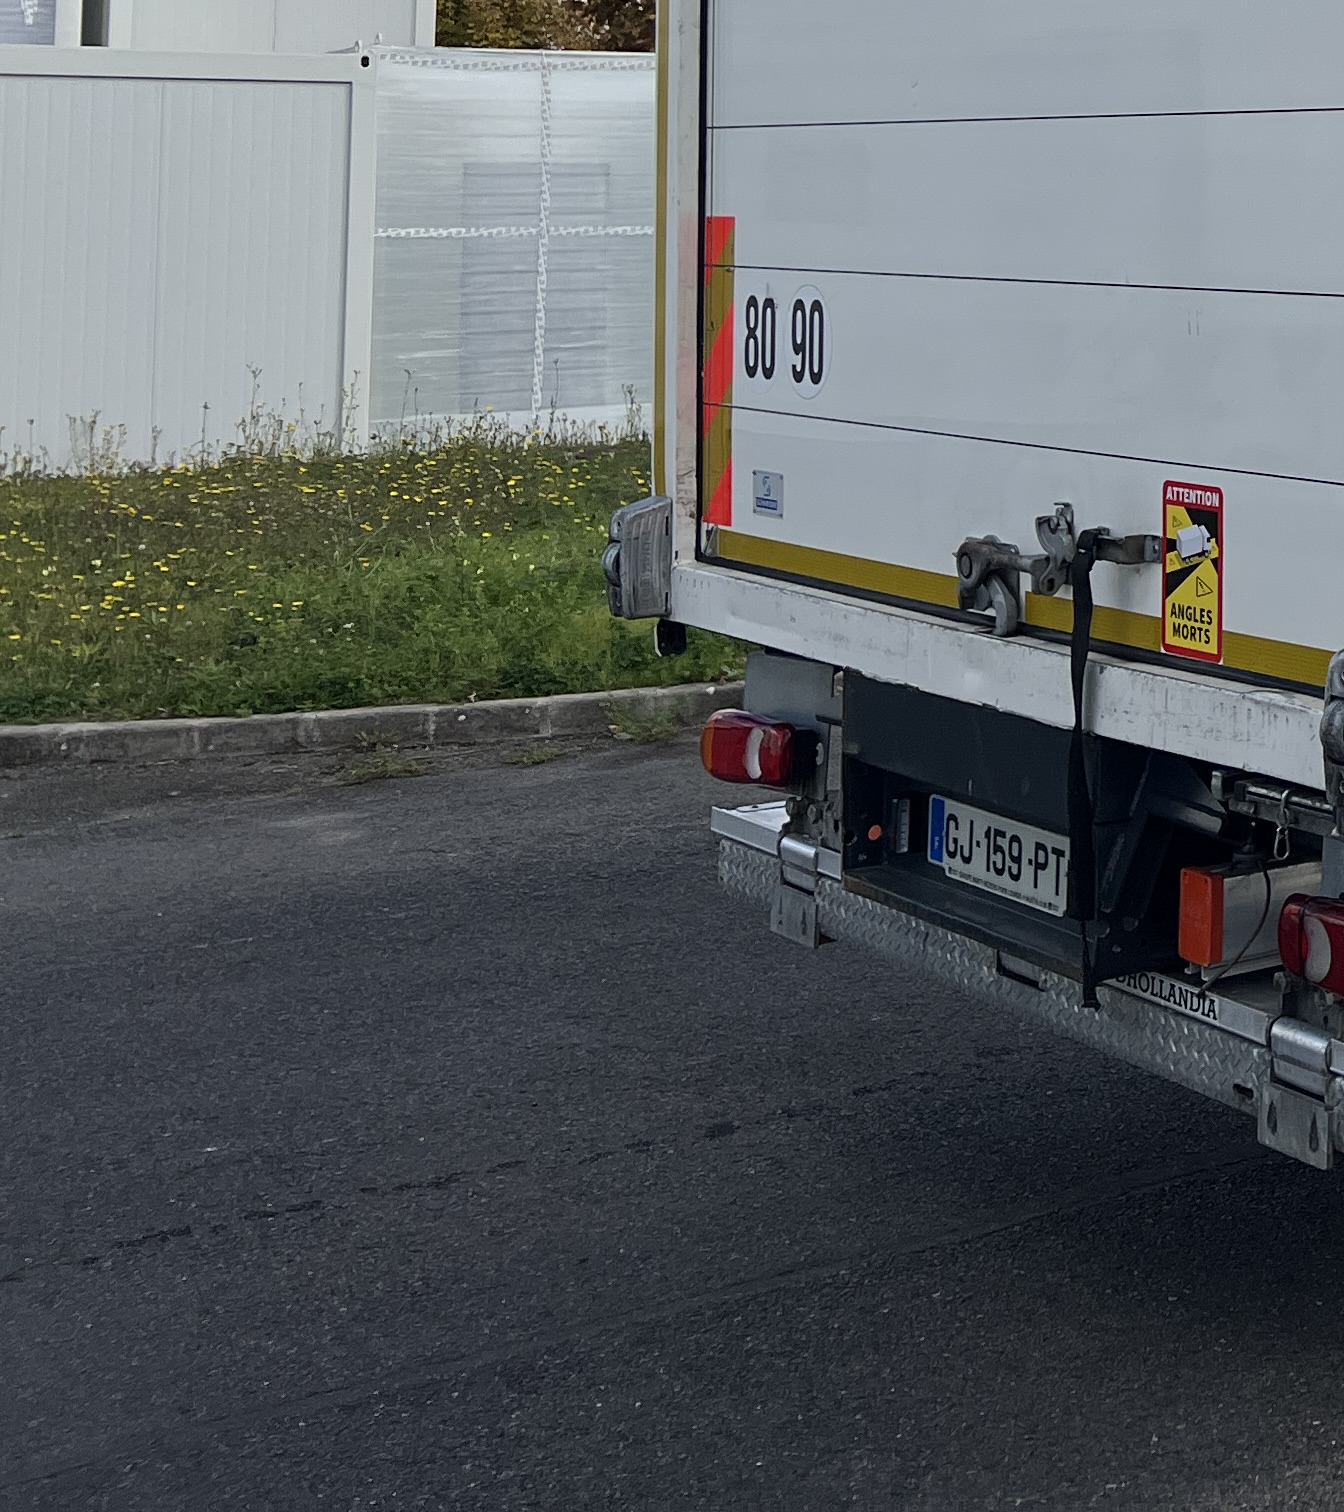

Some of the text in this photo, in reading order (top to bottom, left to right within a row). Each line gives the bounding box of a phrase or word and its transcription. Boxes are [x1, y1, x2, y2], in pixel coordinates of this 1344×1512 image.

[744, 294, 776, 380] 80
[791, 298, 824, 385] 90
[1166, 486, 1220, 508] ATTENTION
[1170, 602, 1213, 626] ANGLES
[1172, 622, 1210, 645] MORTS
[945, 813, 1066, 897] GJ-159-PT
